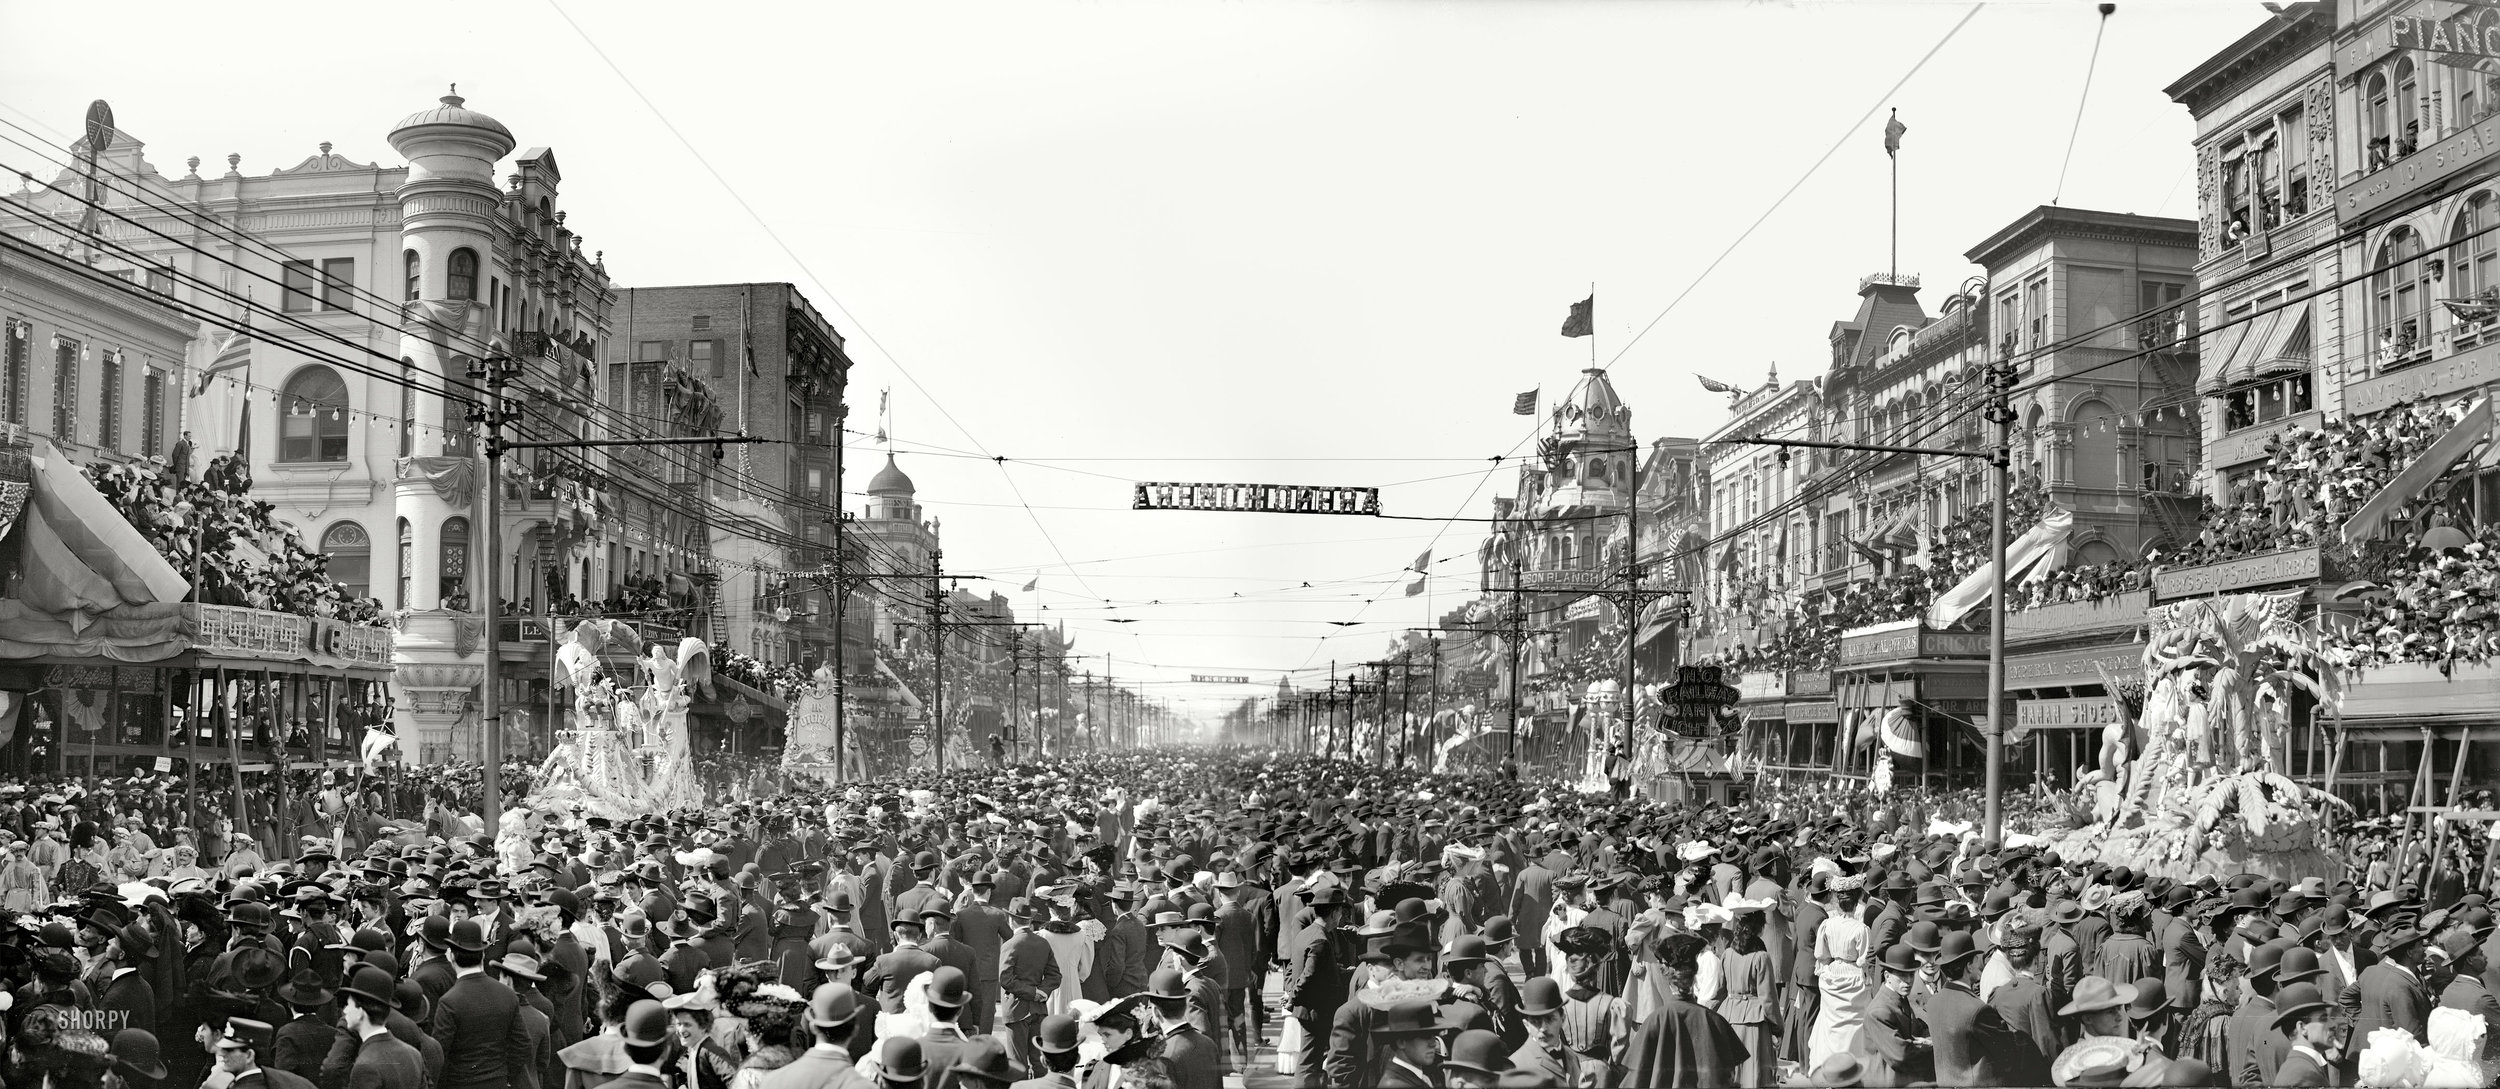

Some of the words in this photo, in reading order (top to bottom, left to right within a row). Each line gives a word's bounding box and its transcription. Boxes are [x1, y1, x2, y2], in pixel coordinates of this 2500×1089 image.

[2346, 191, 2357, 208] 5
[2368, 179, 2390, 197] AND
[2435, 126, 2495, 169] STORE
[2356, 369, 2439, 408] ANYTHING
[2448, 358, 2480, 385] FOR
[2158, 573, 2194, 597] KIRBY'S
[2271, 553, 2318, 579] KIRBY'S
[1925, 635, 1989, 652] CHICAG
[2009, 661, 2060, 680] IMPERIAL
[2064, 657, 2096, 674] SHOE
[1665, 684, 1738, 704] RAILWAY
[1682, 703, 1718, 718] AND
[1965, 700, 2012, 713] ARMD
[2021, 703, 2062, 725] HANAN
[2070, 702, 2117, 724] SHOES
